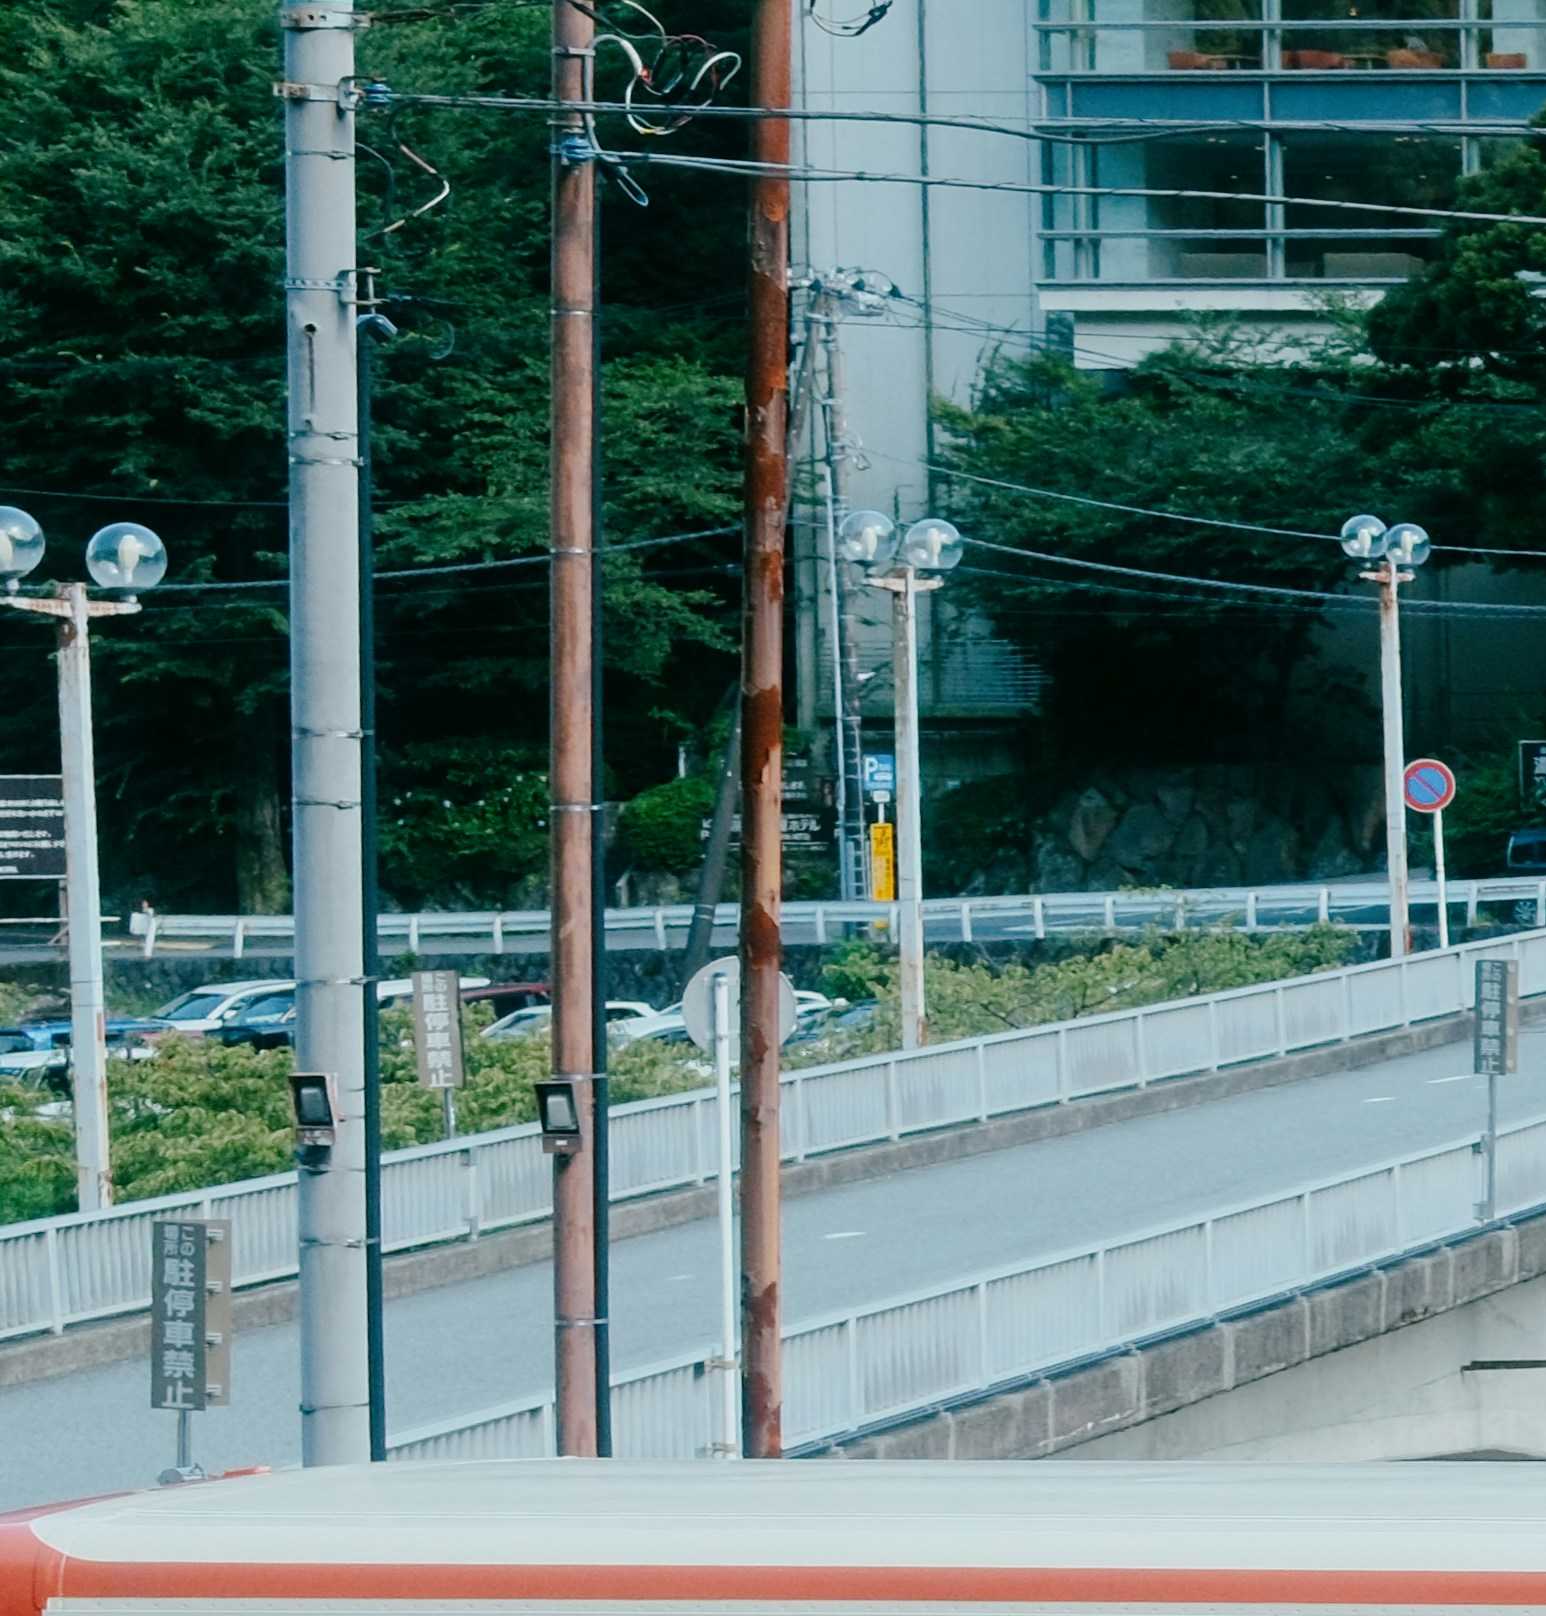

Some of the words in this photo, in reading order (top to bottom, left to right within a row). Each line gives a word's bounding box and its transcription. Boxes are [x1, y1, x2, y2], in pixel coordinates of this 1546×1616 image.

[864, 757, 878, 782] P
[161, 1258, 195, 1409] 駐停車禁止
